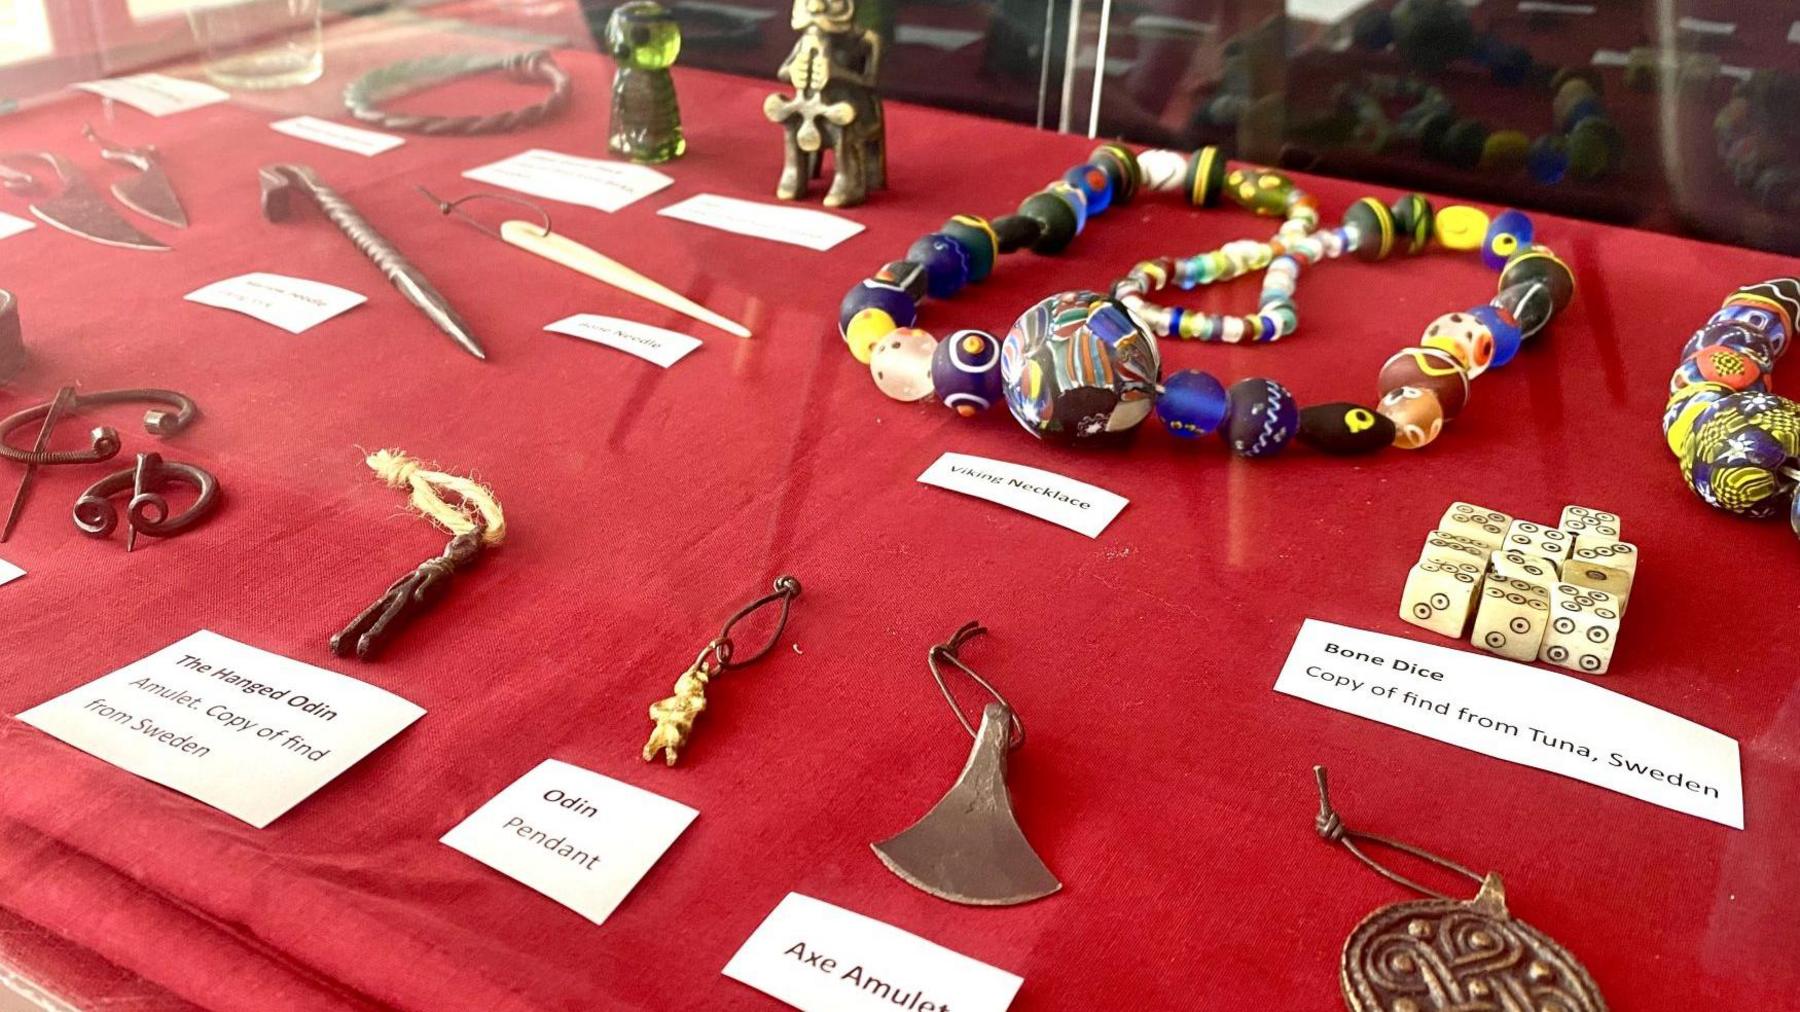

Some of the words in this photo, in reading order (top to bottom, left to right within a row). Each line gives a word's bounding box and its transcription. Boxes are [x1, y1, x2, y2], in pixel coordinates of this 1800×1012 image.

[950, 465, 1004, 485] Viking
[1007, 478, 1091, 510] Necklace
[176, 653, 212, 675] The
[210, 667, 291, 702] Hanged
[286, 695, 339, 723] Odin
[1323, 642, 1386, 668] Bone
[1392, 658, 1445, 682] Dice
[83, 698, 133, 727] from
[130, 718, 212, 758] Sweden
[128, 676, 200, 711] Amulet.
[206, 704, 258, 735] Copy
[257, 722, 287, 744] of
[282, 735, 332, 764] find
[1305, 665, 1365, 692] Copy
[1370, 681, 1401, 700] of
[1401, 690, 1451, 716] find
[1456, 706, 1520, 736] from
[1528, 727, 1599, 763] Tuna,
[1608, 752, 1721, 800] Sweden
[542, 788, 599, 819] Odin
[502, 816, 602, 871] Pendant
[783, 942, 838, 974] Axe
